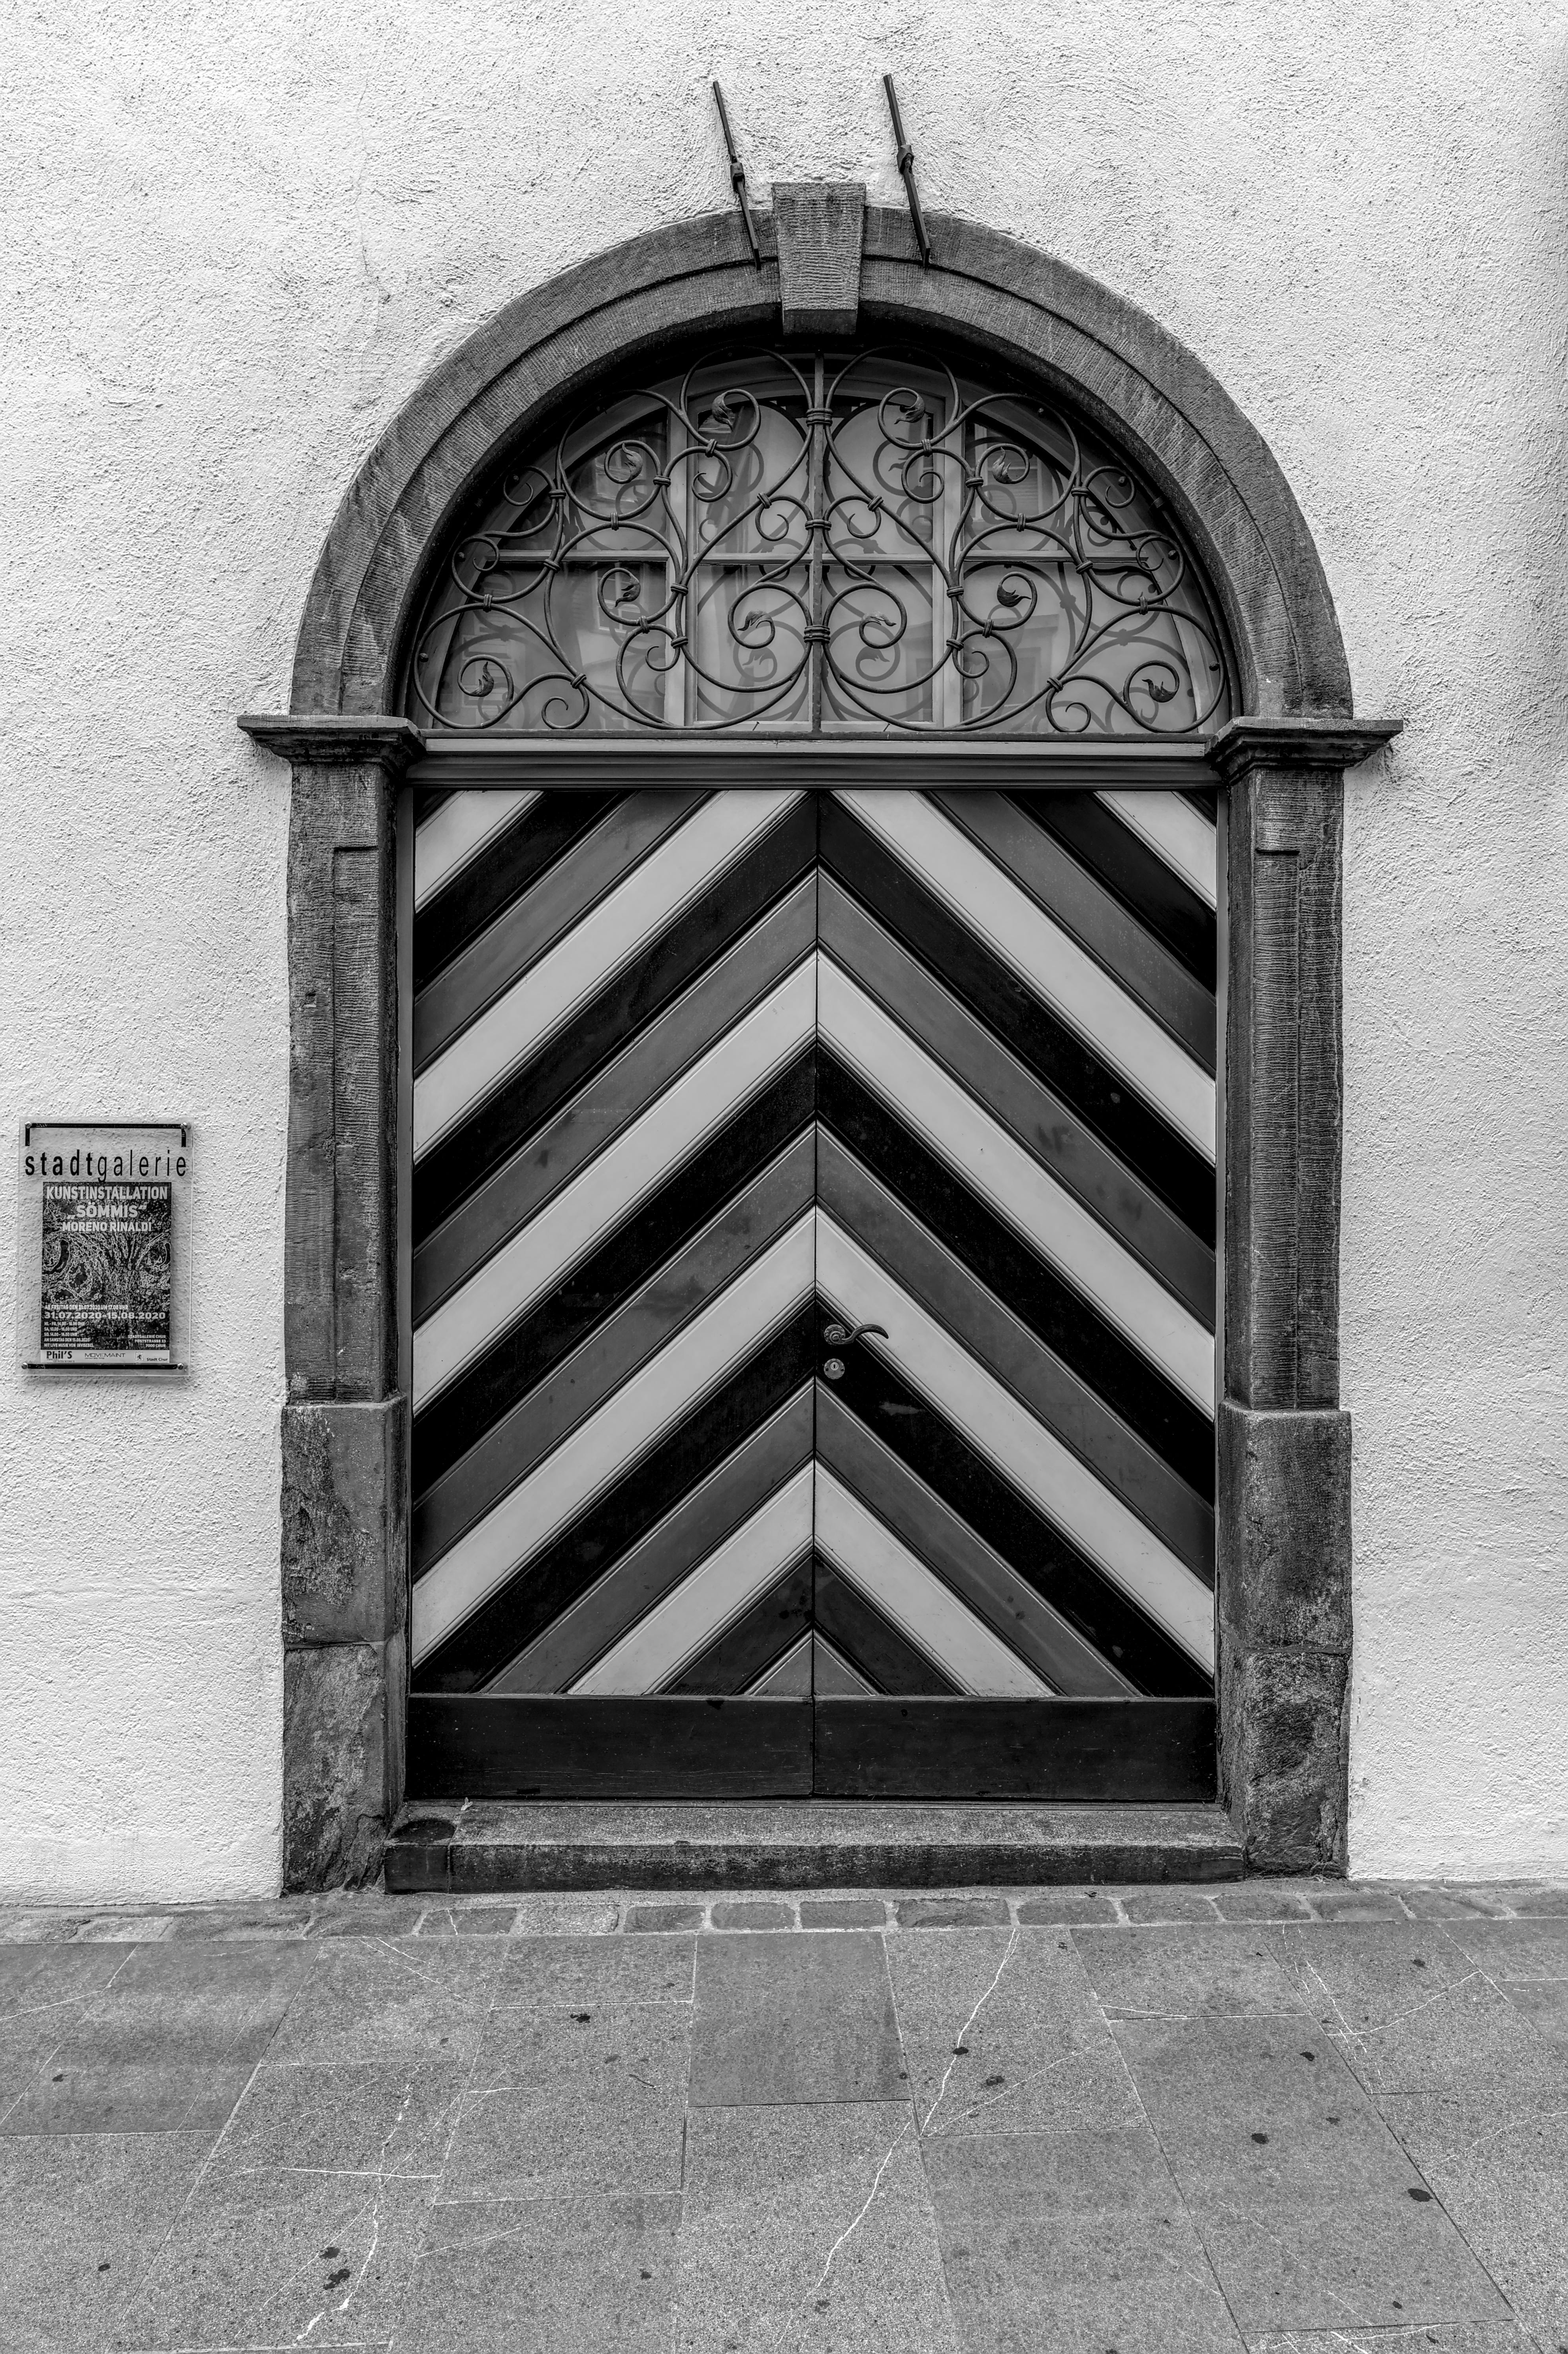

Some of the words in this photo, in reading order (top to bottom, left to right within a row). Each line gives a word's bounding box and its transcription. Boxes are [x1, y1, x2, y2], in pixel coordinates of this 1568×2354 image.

[25, 1149, 186, 1183] stadtgalerie
[46, 1186, 167, 1200] KUNSTINSTALLATION
[62, 1222, 108, 1232] MORENO
[110, 1222, 152, 1232] RINALDI
